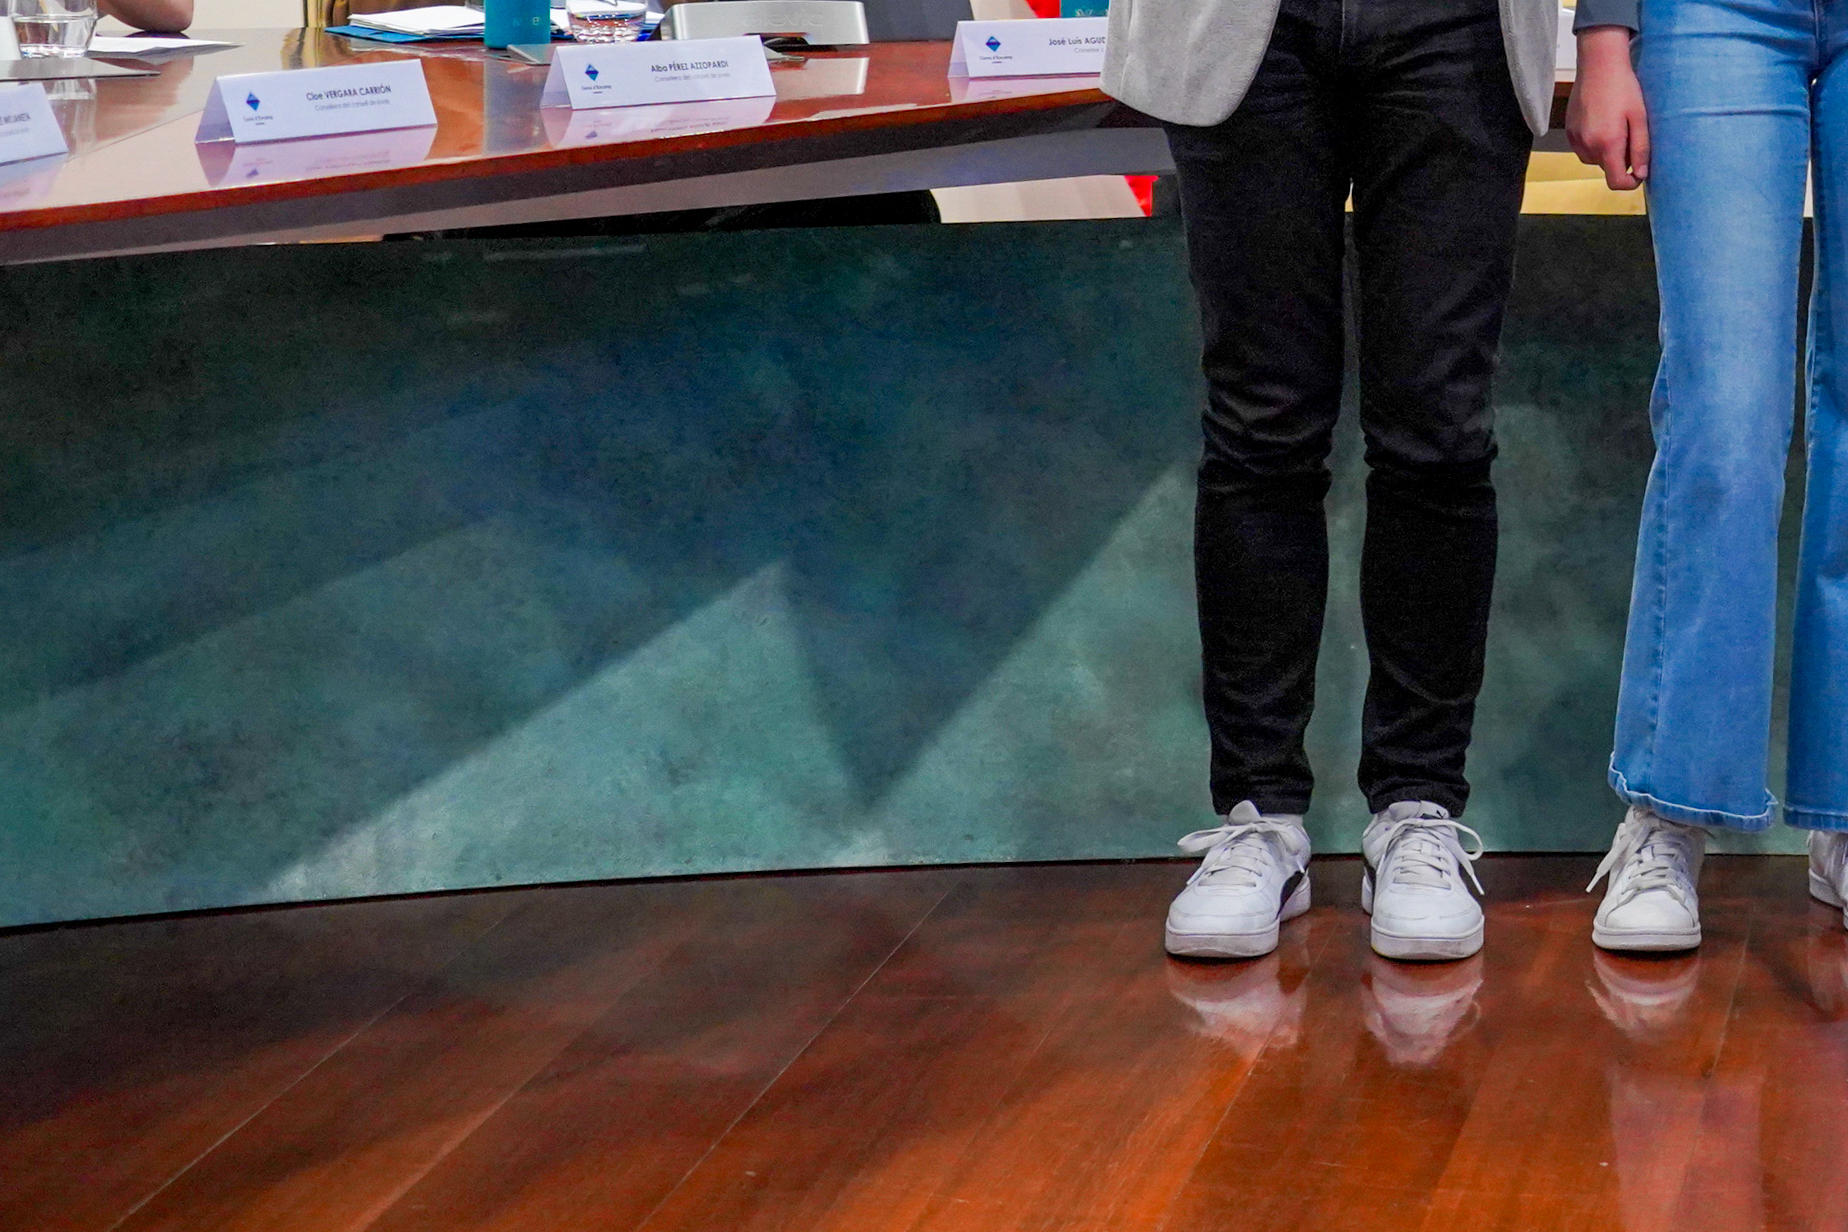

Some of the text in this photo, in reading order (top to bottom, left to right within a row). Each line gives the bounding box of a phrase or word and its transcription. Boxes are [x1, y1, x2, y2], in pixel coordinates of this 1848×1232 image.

[1049, 37, 1066, 45] José
[651, 60, 729, 72] Alba PÉREZ AZZOPARDI
[324, 88, 358, 99] VERGARA
[359, 83, 391, 96] CARRIÓN
